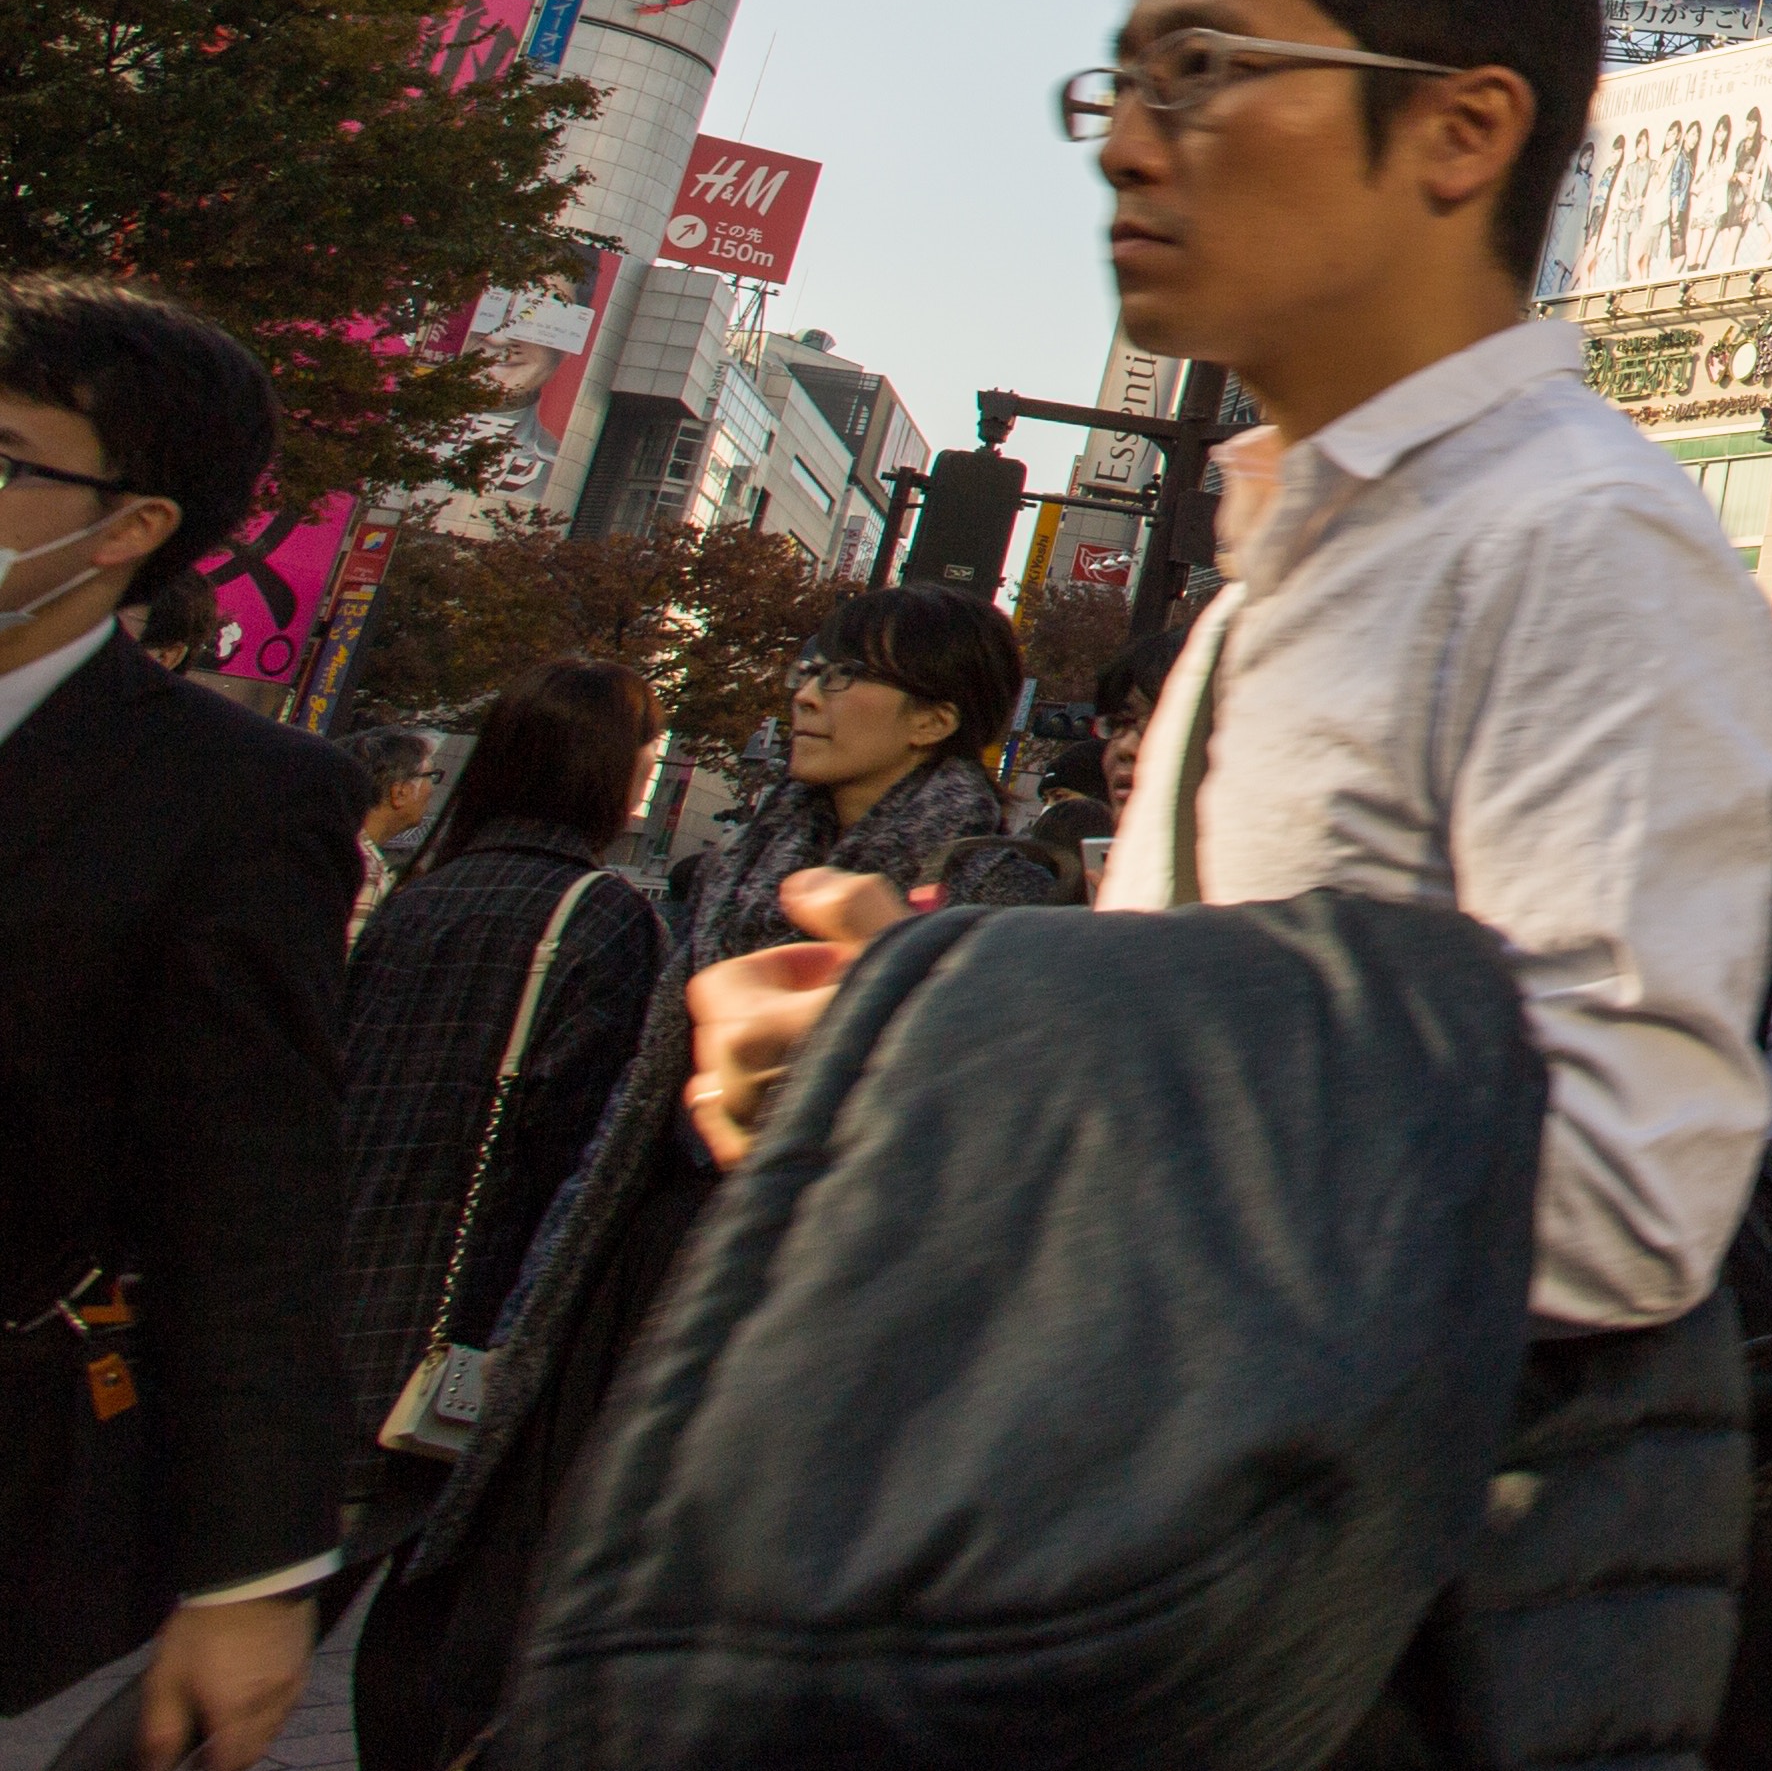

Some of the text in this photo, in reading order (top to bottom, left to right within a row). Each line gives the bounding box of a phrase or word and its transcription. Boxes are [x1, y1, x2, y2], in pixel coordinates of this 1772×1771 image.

[689, 155, 791, 218] H&M
[713, 219, 764, 245] この先
[707, 236, 775, 269] 150m
